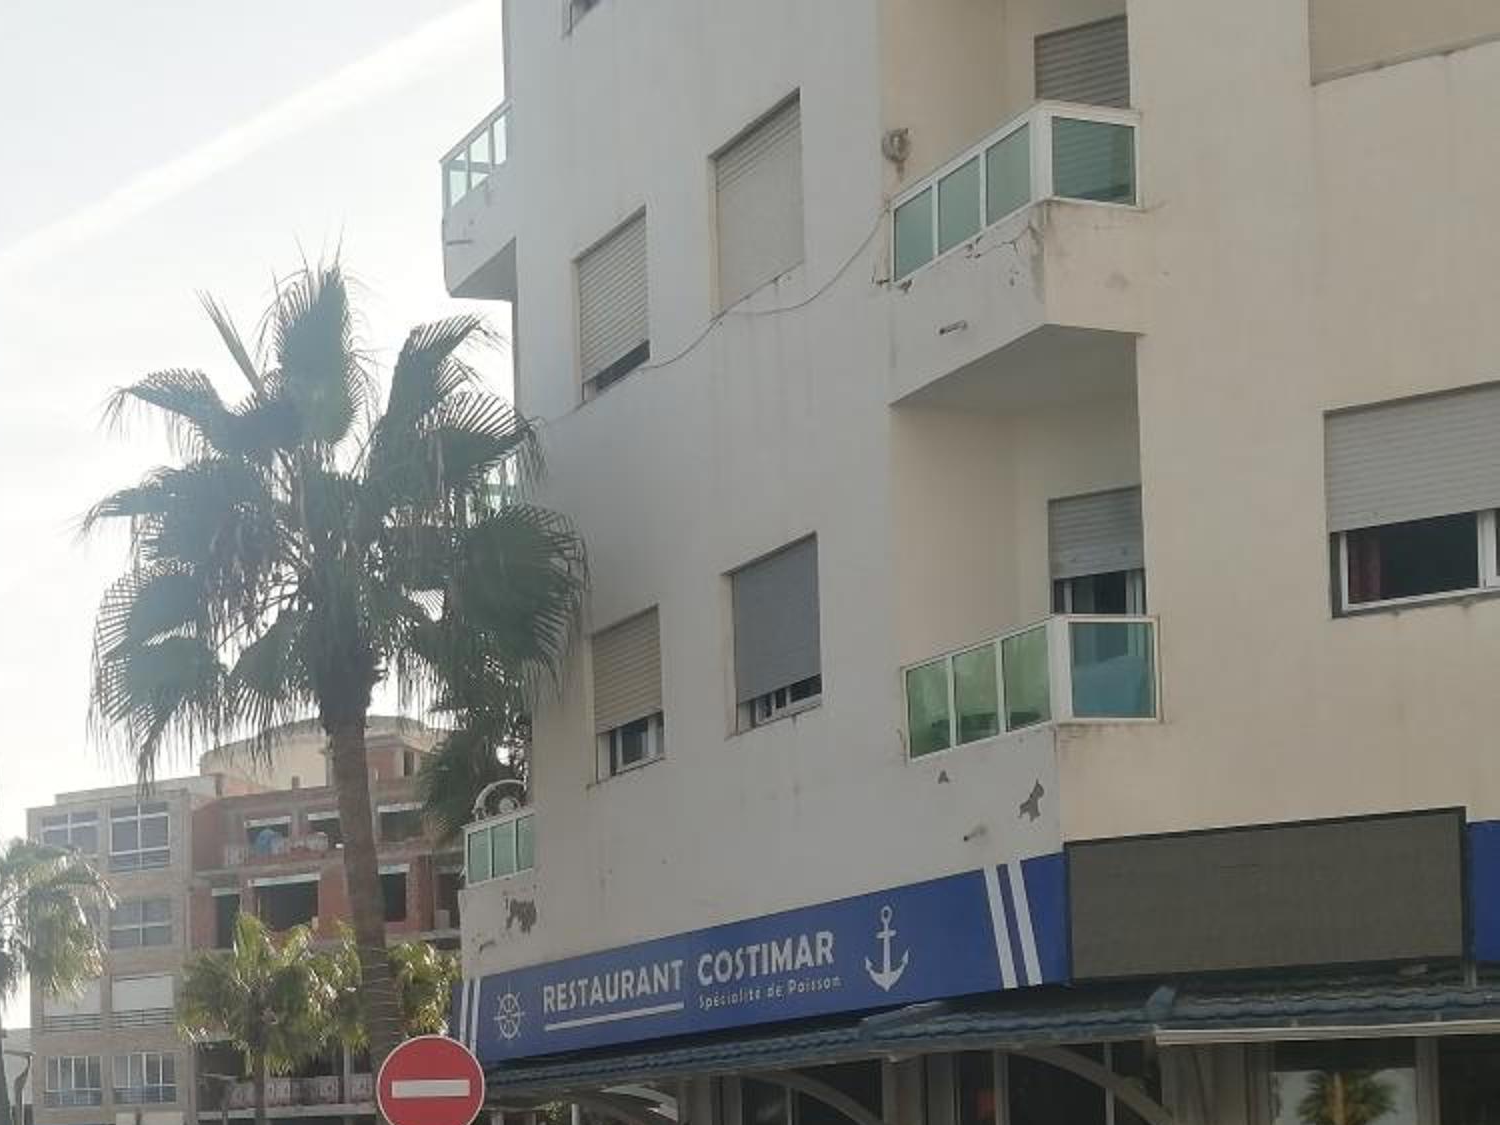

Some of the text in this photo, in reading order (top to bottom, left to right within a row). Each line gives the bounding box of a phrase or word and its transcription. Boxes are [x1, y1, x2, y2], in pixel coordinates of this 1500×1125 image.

[543, 930, 835, 1016] RESTAURANT COSTIMAR
[788, 975, 843, 994] Poisson
